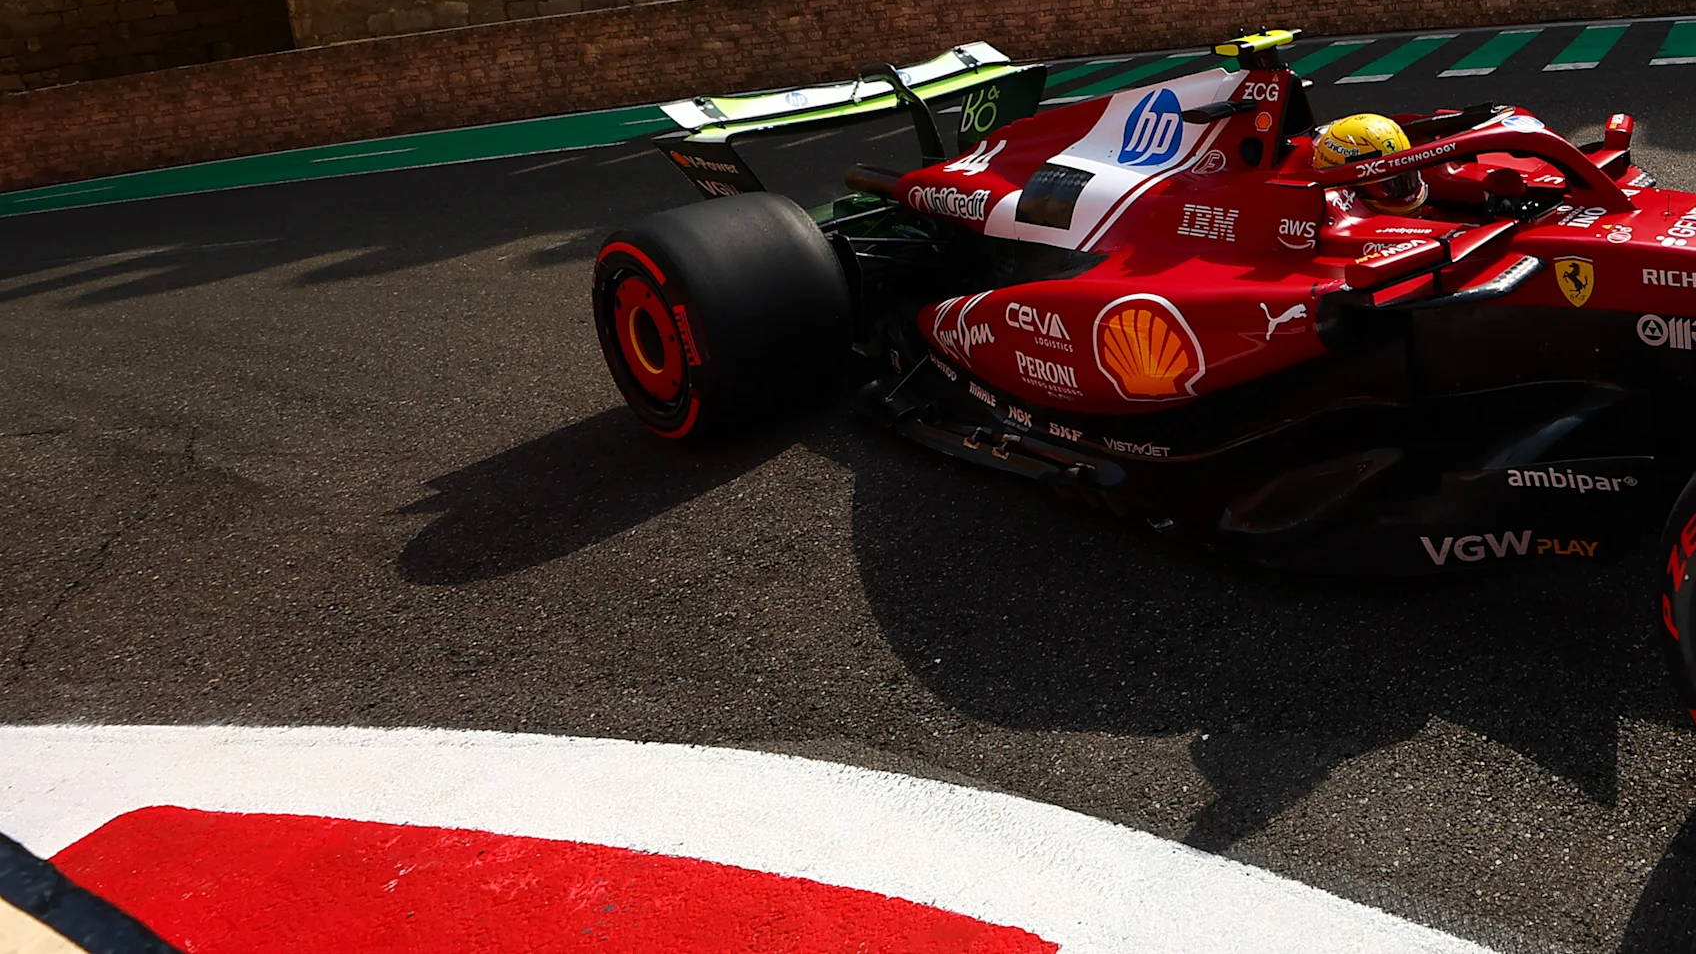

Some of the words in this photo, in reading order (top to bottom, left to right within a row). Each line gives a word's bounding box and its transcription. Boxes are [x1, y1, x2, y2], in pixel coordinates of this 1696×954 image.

[1120, 90, 1182, 166] hp
[943, 139, 1007, 176] 44
[1388, 142, 1457, 168] TECHNOLOGY
[923, 187, 991, 221] UniCredit
[1177, 204, 1239, 242] IBM
[1279, 219, 1317, 239] aws
[1034, 336, 1074, 353] LOGISTICS
[1014, 350, 1079, 389] PERONI
[1008, 405, 1032, 427] NGK
[1049, 422, 1083, 442] SKF
[1507, 467, 1622, 493] ambipar
[1420, 530, 1532, 566] VGW
[1537, 538, 1599, 557] PLAY
